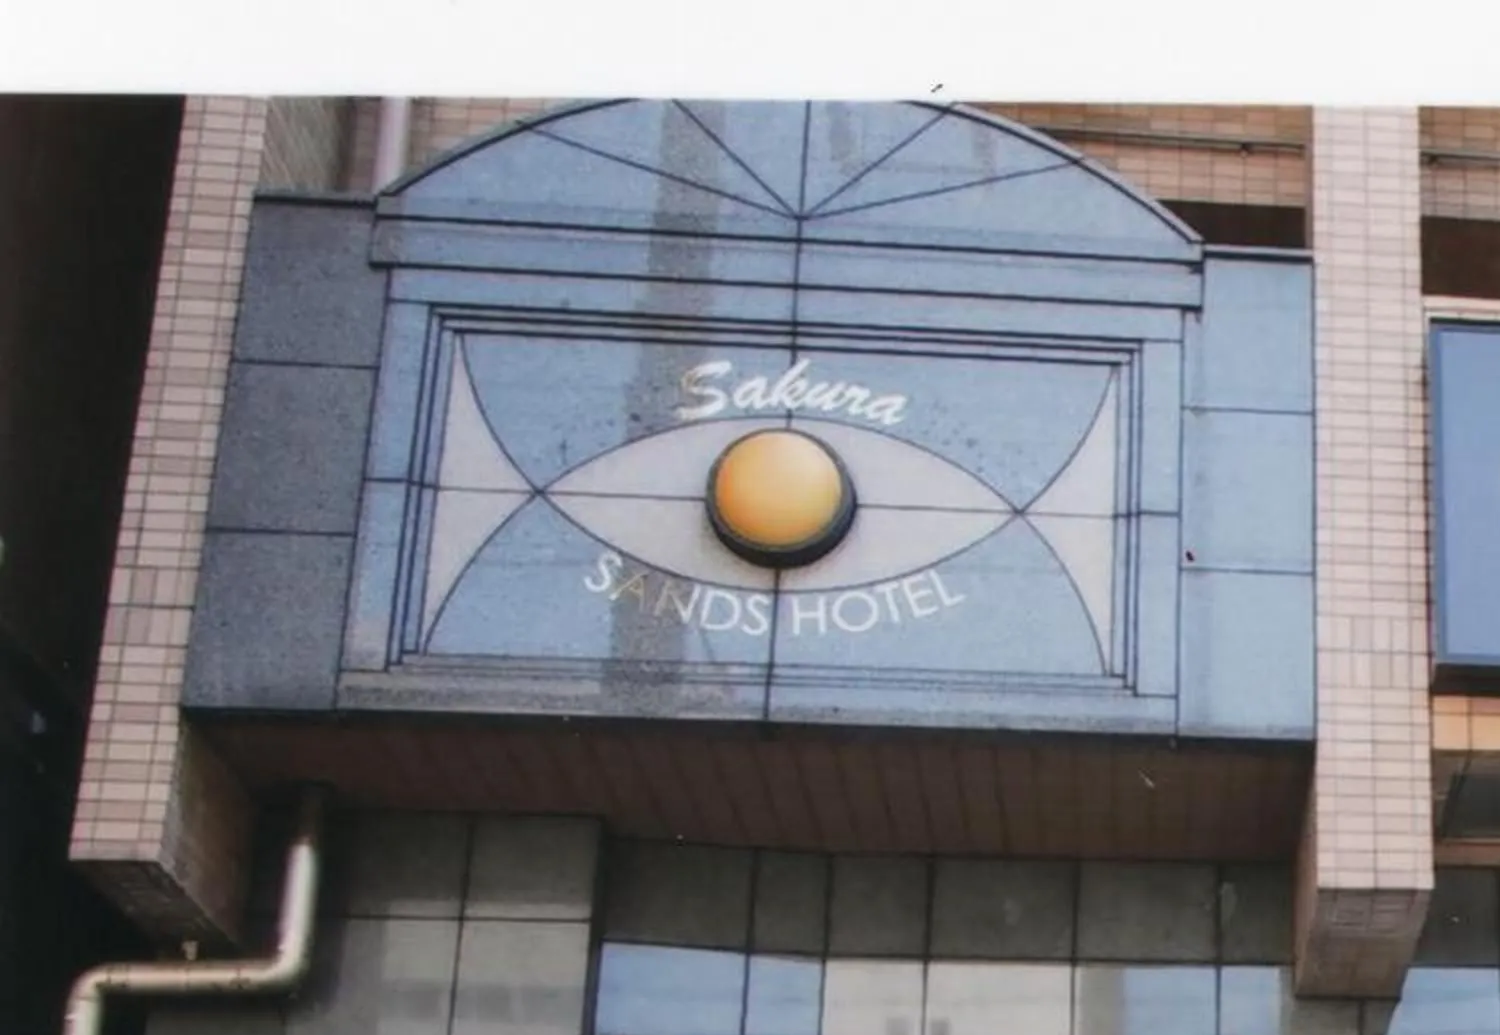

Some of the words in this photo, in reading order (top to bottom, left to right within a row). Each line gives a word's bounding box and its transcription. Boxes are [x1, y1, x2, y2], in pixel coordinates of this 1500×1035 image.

[673, 358, 909, 425] Sakura
[583, 551, 772, 636] SANDS
[792, 569, 966, 635] HOTEL
